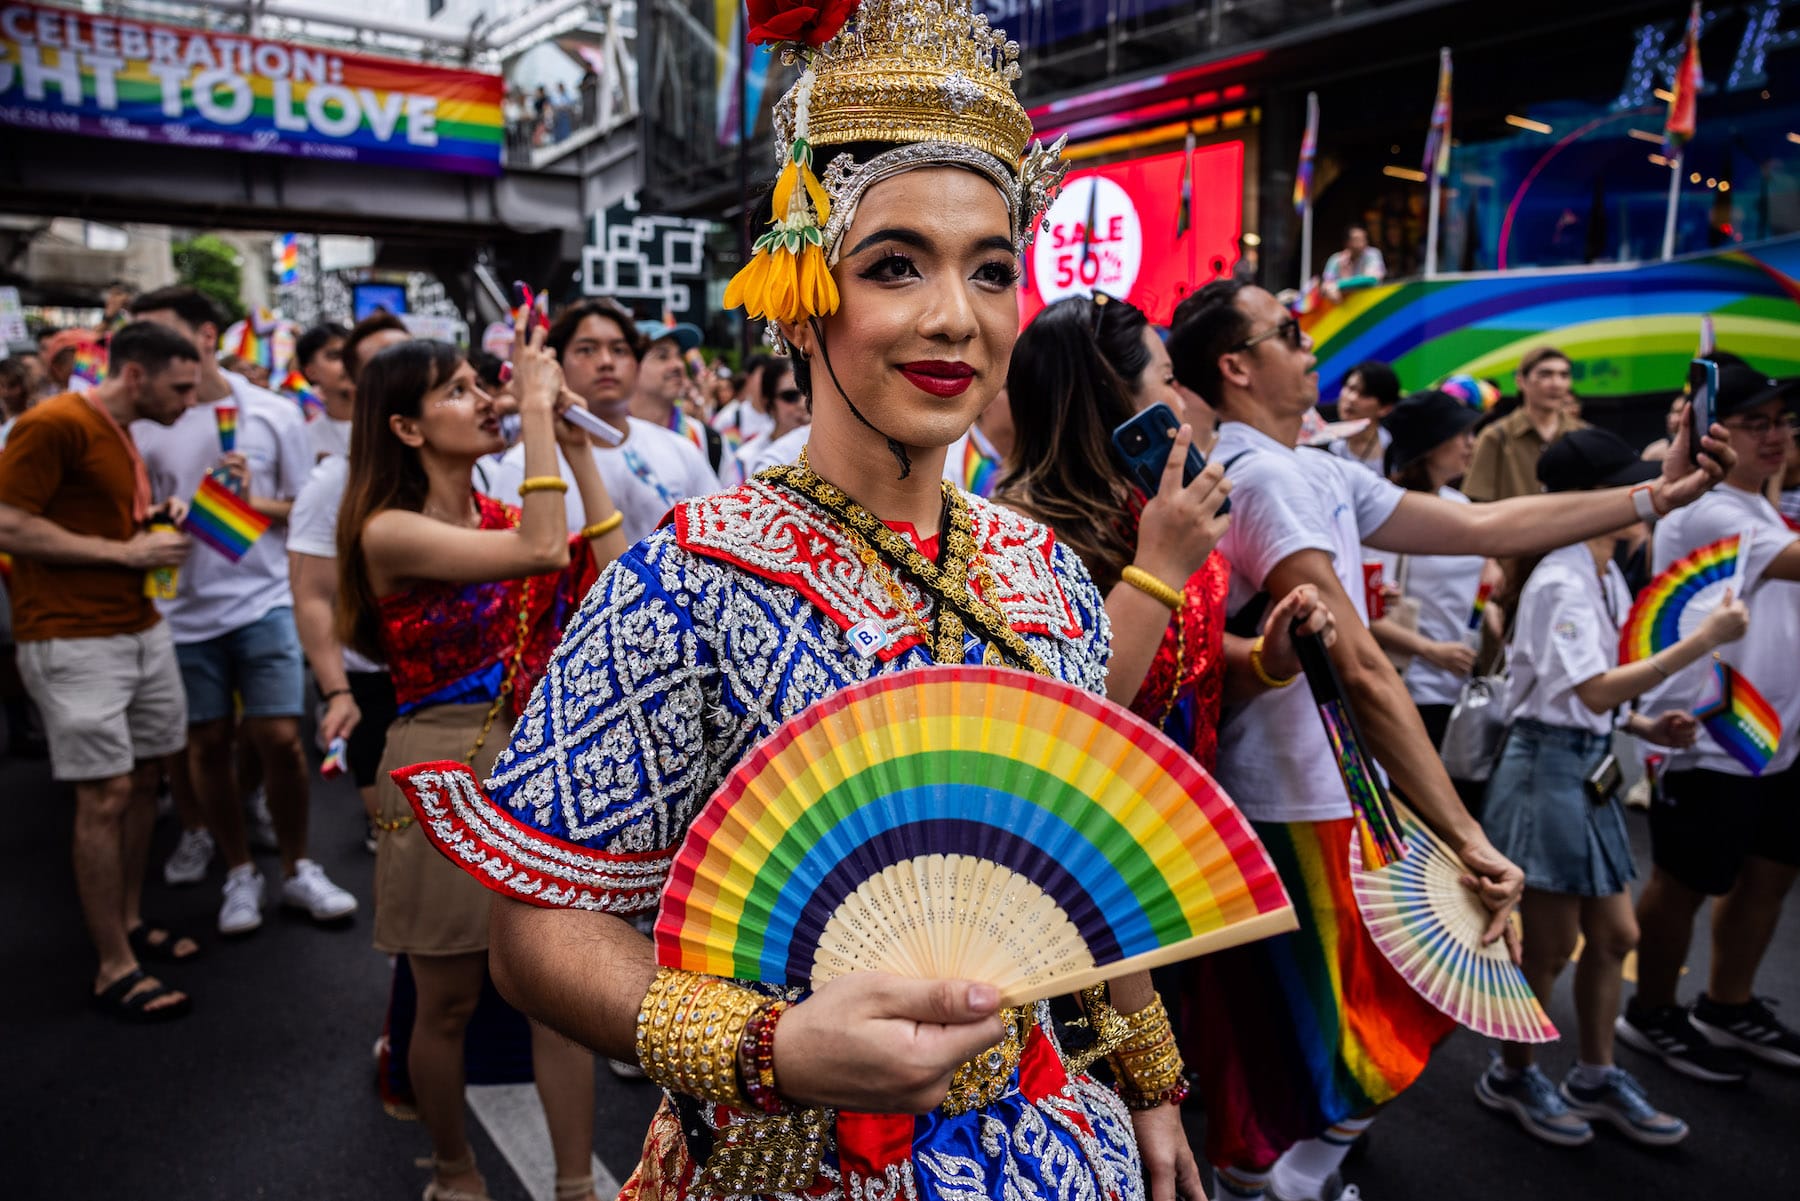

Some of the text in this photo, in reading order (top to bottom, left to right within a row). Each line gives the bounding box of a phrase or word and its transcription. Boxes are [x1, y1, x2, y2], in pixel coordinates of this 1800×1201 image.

[1, 5, 345, 83] CELEBRATION:
[147, 62, 254, 125] TO
[272, 78, 438, 148] LOVE
[1052, 214, 1123, 249] SALE
